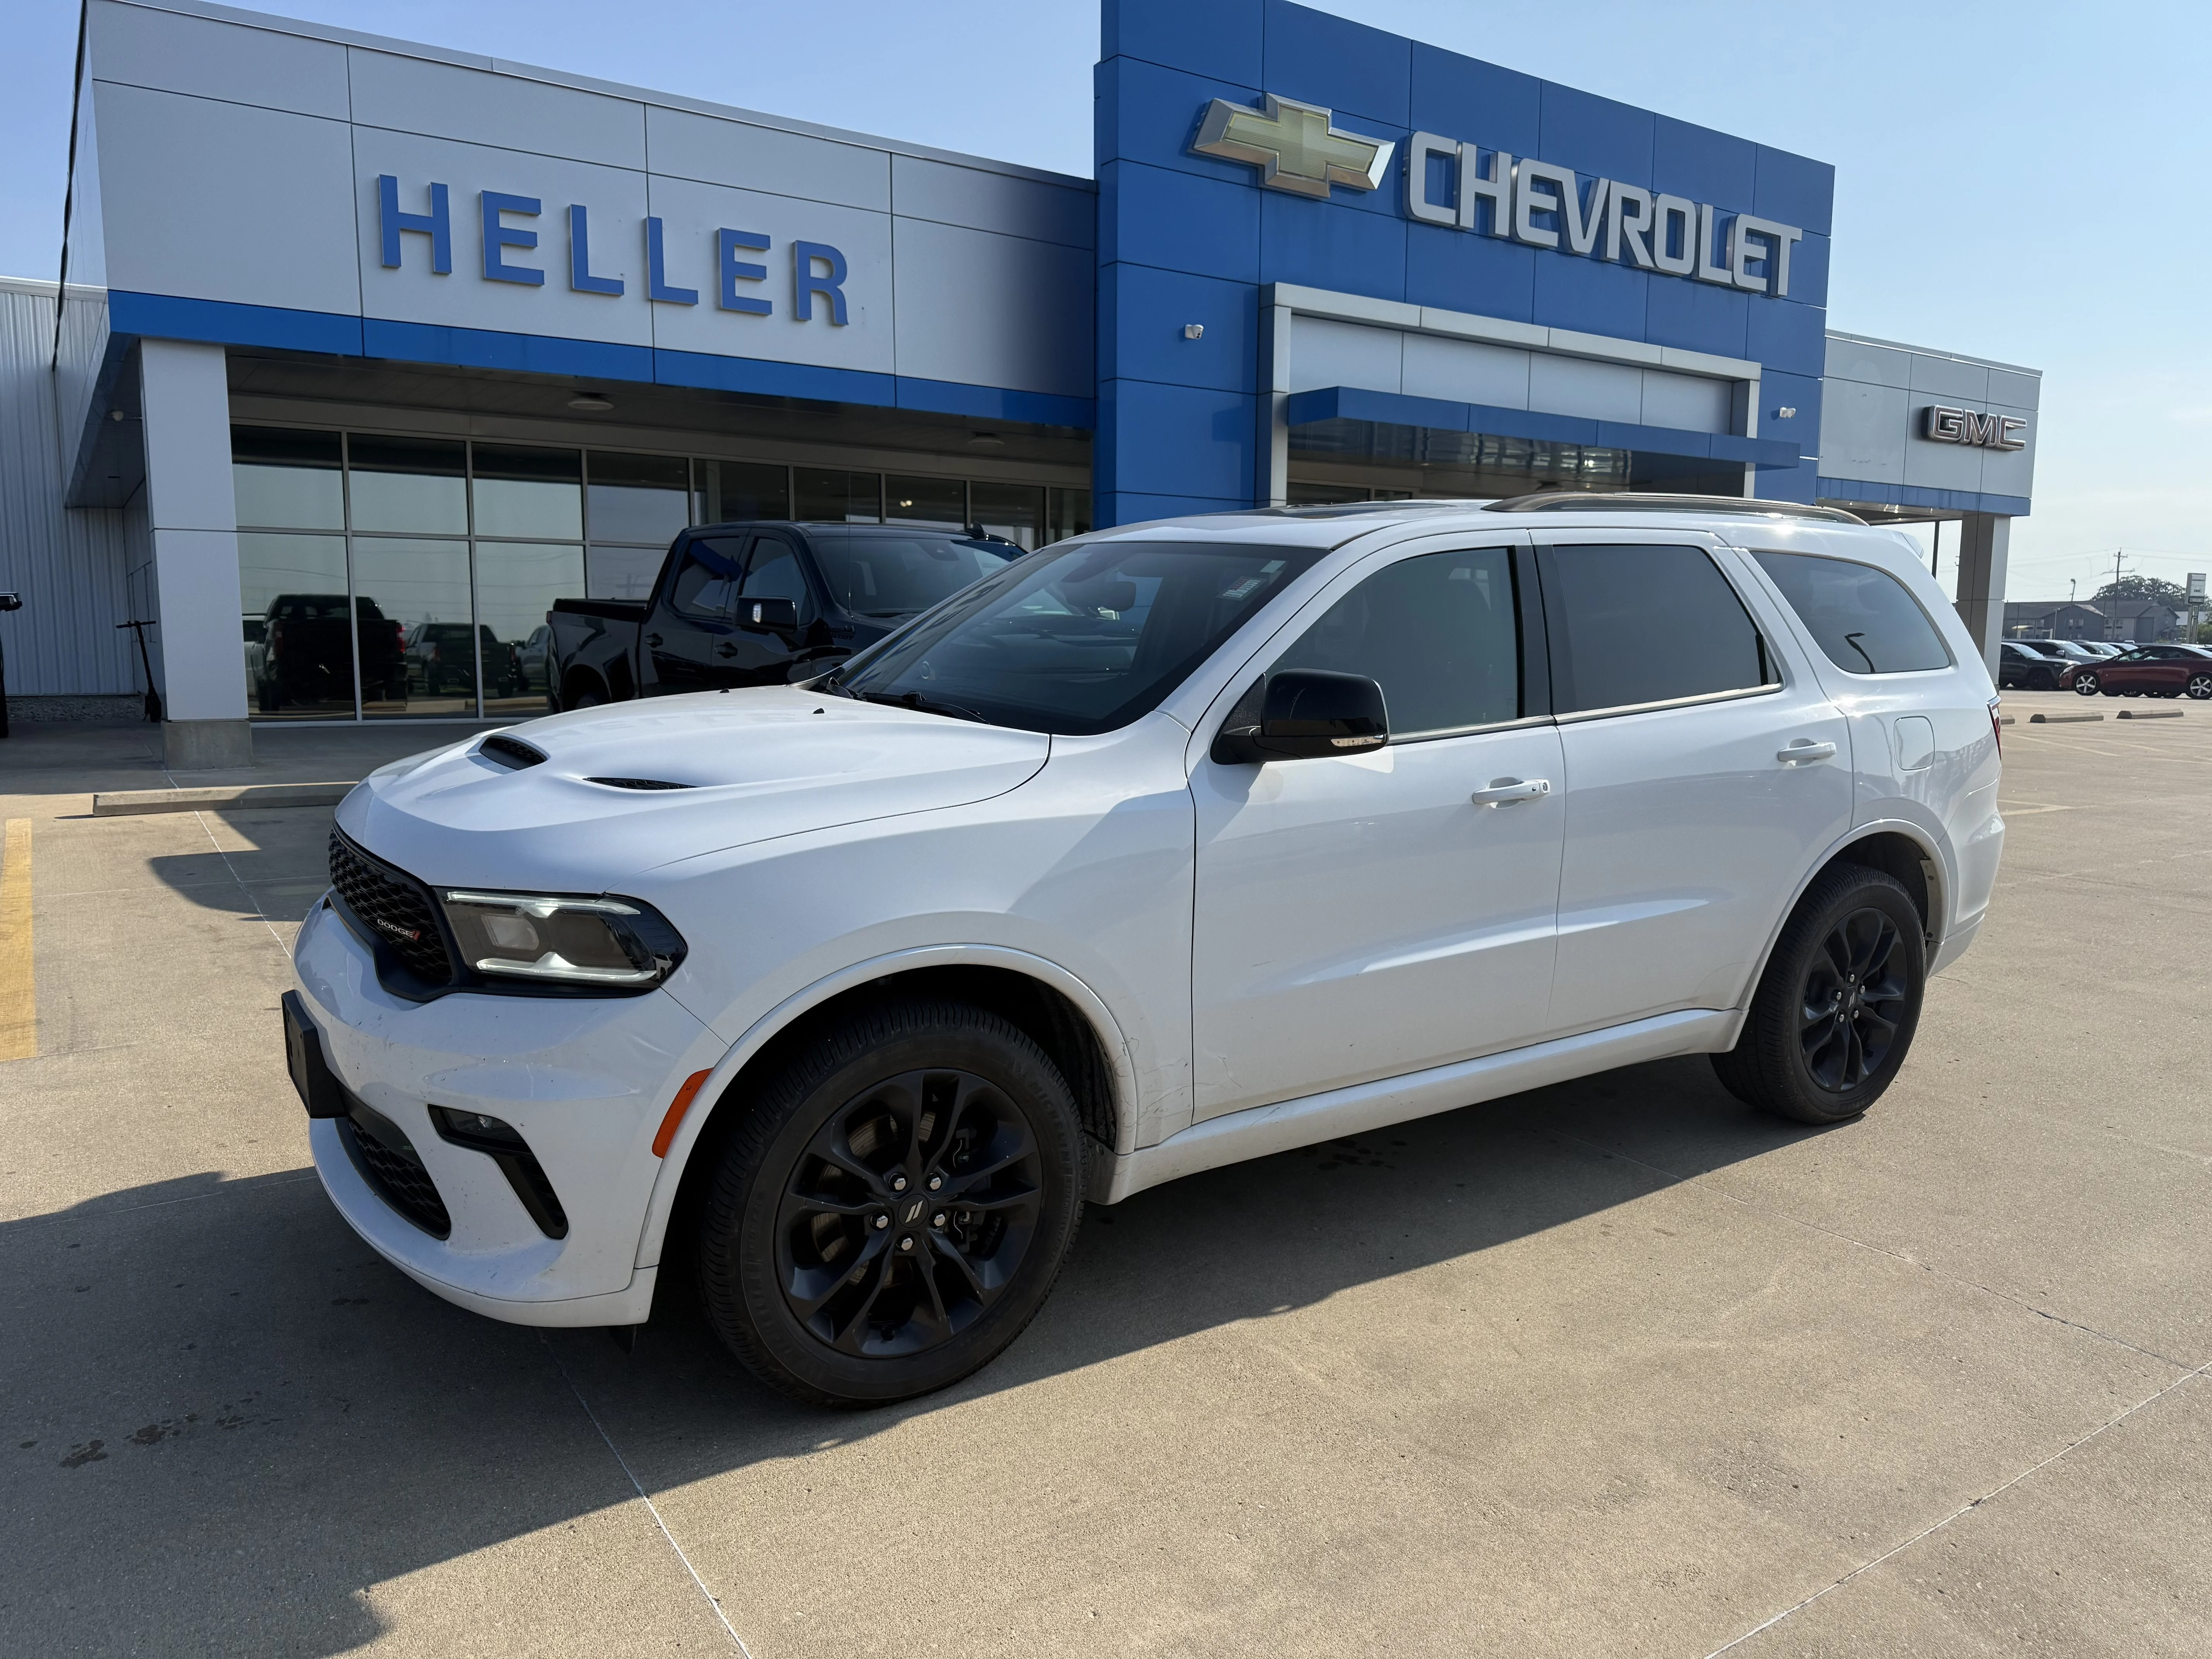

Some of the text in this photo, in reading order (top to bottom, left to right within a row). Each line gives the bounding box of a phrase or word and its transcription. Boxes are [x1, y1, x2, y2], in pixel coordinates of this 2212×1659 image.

[378, 174, 848, 326] HELLER
[1403, 131, 1803, 297] CHEVROLET
[1928, 405, 2027, 450] GMC
[377, 919, 414, 938] DODGE
[1028, 1080, 1071, 1163] MICHELIN
